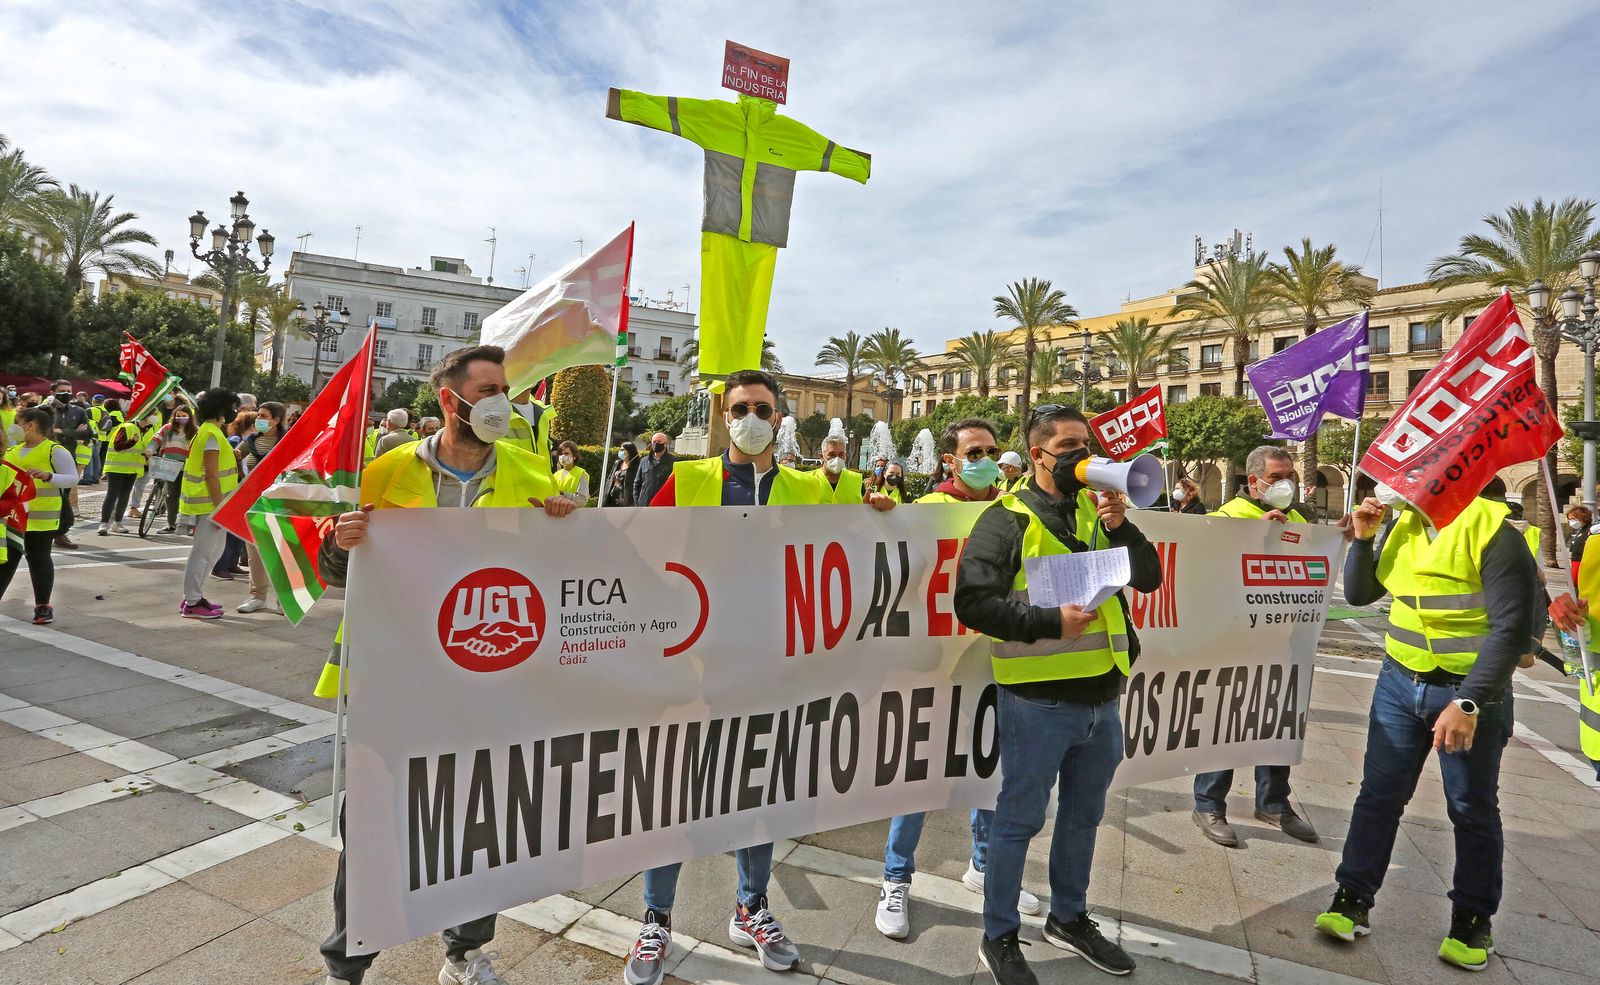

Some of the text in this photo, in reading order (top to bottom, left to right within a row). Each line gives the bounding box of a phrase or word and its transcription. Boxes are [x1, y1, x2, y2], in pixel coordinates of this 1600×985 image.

[725, 64, 787, 89] AL FIN DE LA
[723, 74, 785, 101] INDUSTRIA
[1246, 560, 1307, 580] CCOO
[560, 577, 628, 608] FICA
[784, 541, 852, 657] NO
[855, 540, 910, 642] AL
[1246, 590, 1324, 605] construcció
[452, 585, 531, 628] UGT
[560, 610, 616, 625] Industria,
[1249, 609, 1321, 629] y servicio
[560, 618, 678, 638] Construcción y Agro
[560, 635, 627, 654] Andalucía
[559, 654, 588, 666] Cádiz
[408, 692, 860, 892] MANTENIMIENTO
[875, 687, 935, 787] DE
[945, 683, 1000, 779] LO
[1166, 670, 1211, 751] DE
[1212, 664, 1304, 745] TRABA
